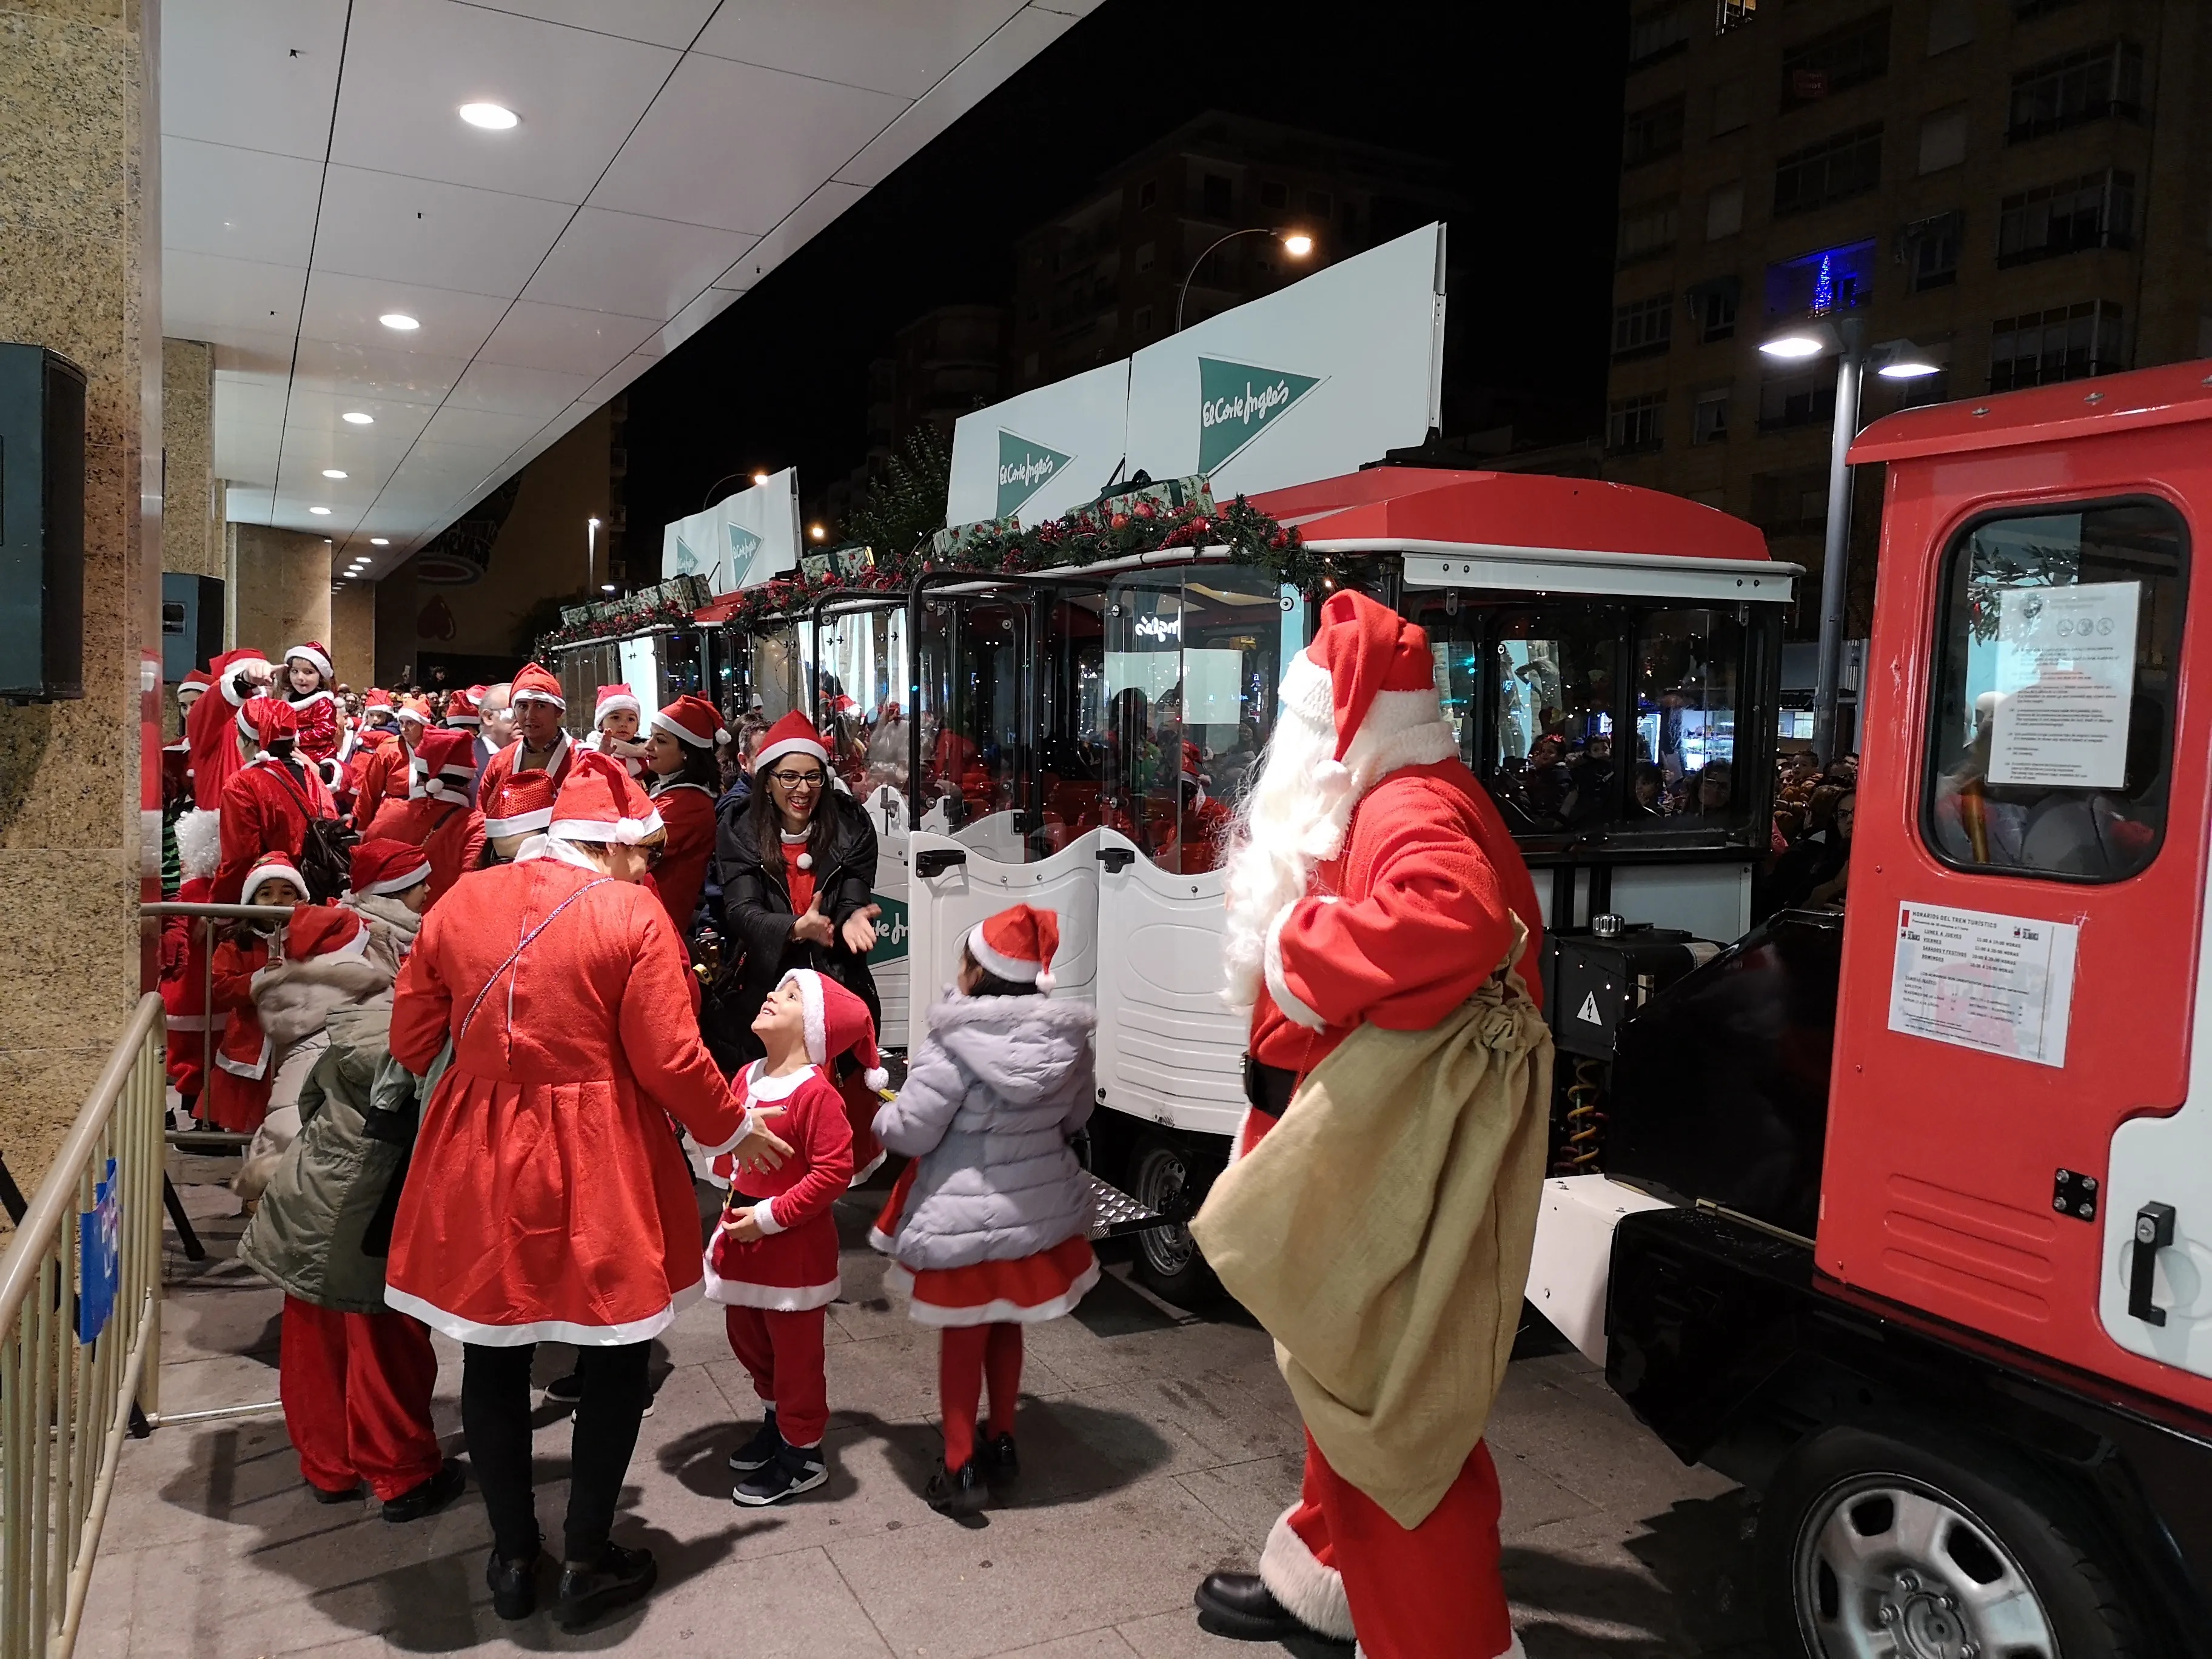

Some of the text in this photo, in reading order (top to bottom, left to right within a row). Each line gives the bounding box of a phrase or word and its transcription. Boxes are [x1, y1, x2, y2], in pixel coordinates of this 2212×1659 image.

[1203, 378, 1289, 427] El Corte Inglés
[1000, 453, 1053, 486] El Corte Inglés
[1912, 911, 1939, 920] HORARIOS
